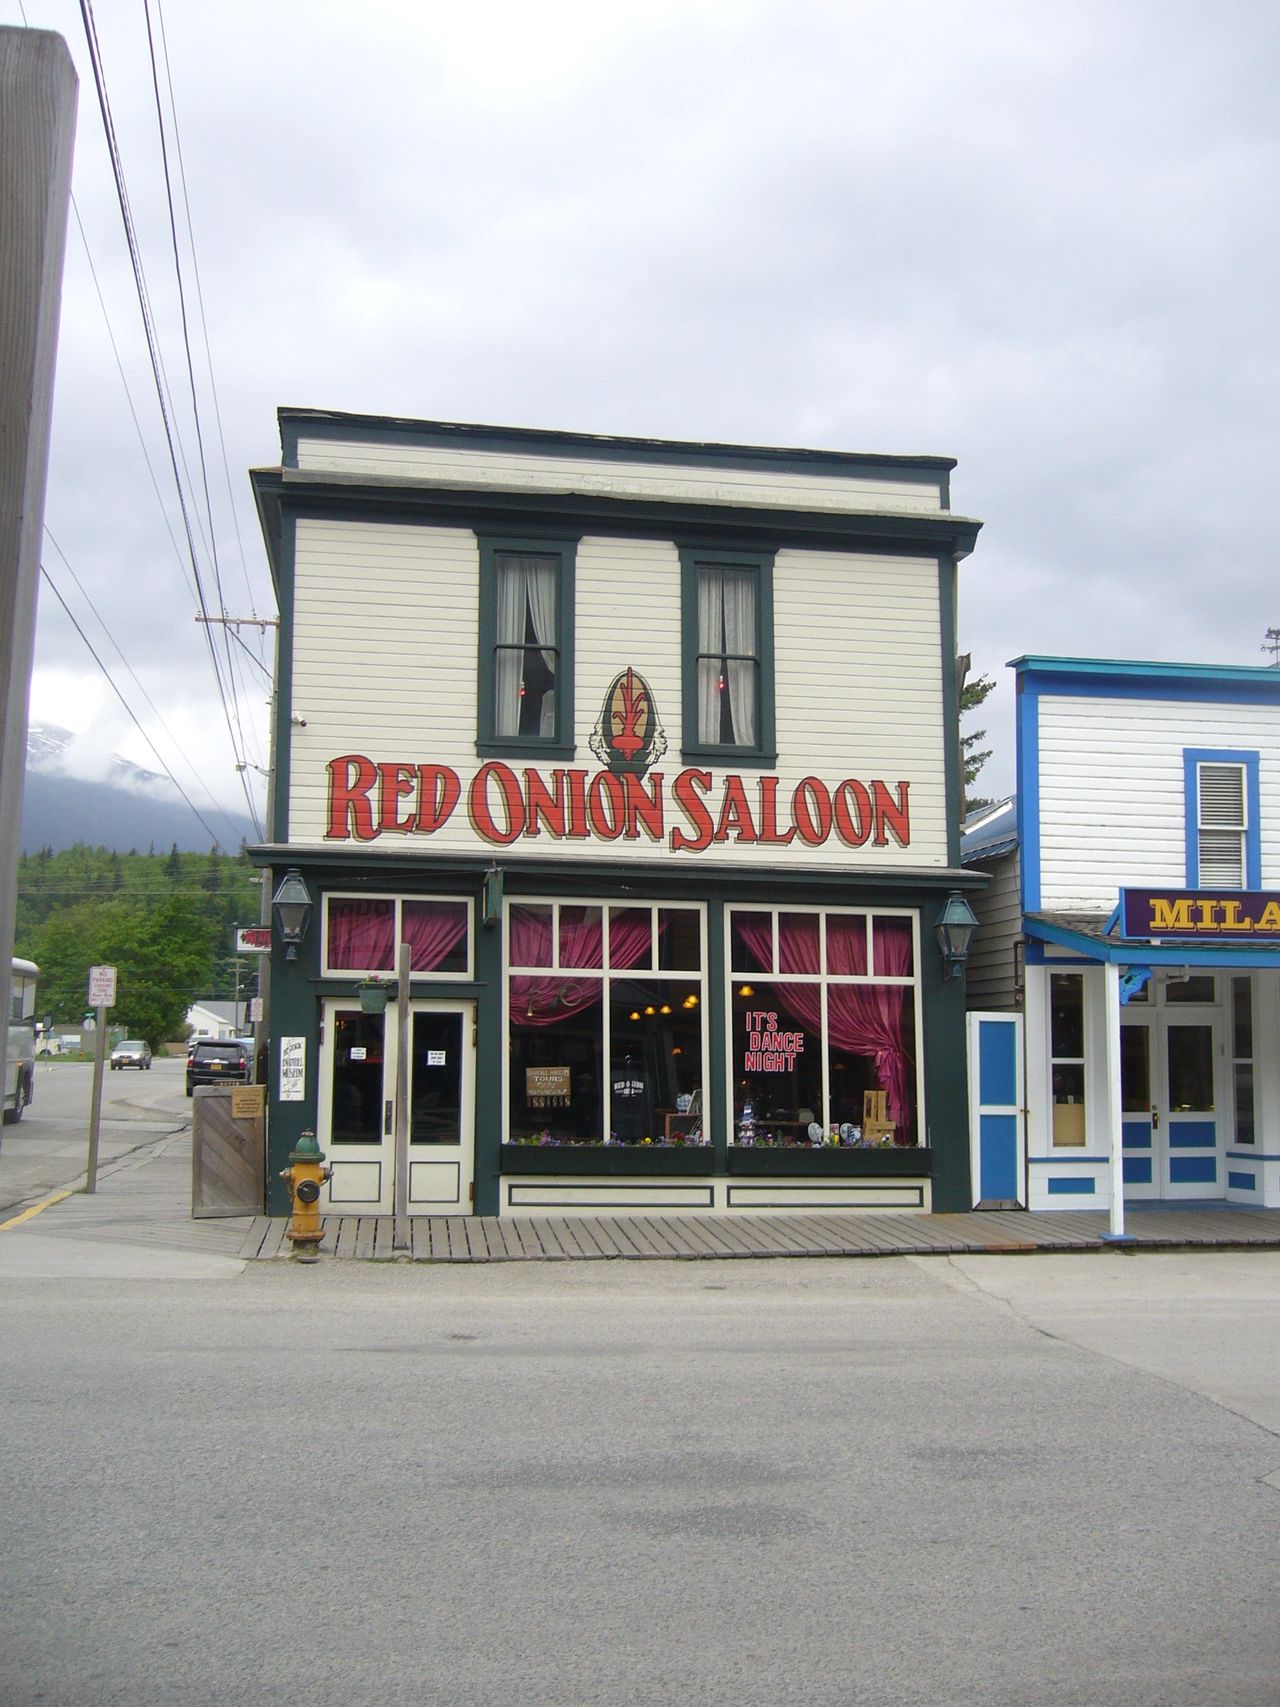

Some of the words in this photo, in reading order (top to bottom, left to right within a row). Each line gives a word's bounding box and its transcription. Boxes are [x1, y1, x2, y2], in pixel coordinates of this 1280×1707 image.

[323, 755, 461, 842] RED
[467, 760, 664, 846] ONION
[669, 768, 911, 854] SALOON
[746, 1012, 777, 1031] IT'S
[750, 1032, 804, 1052] DANCE
[745, 1052, 796, 1072] NIGHT
